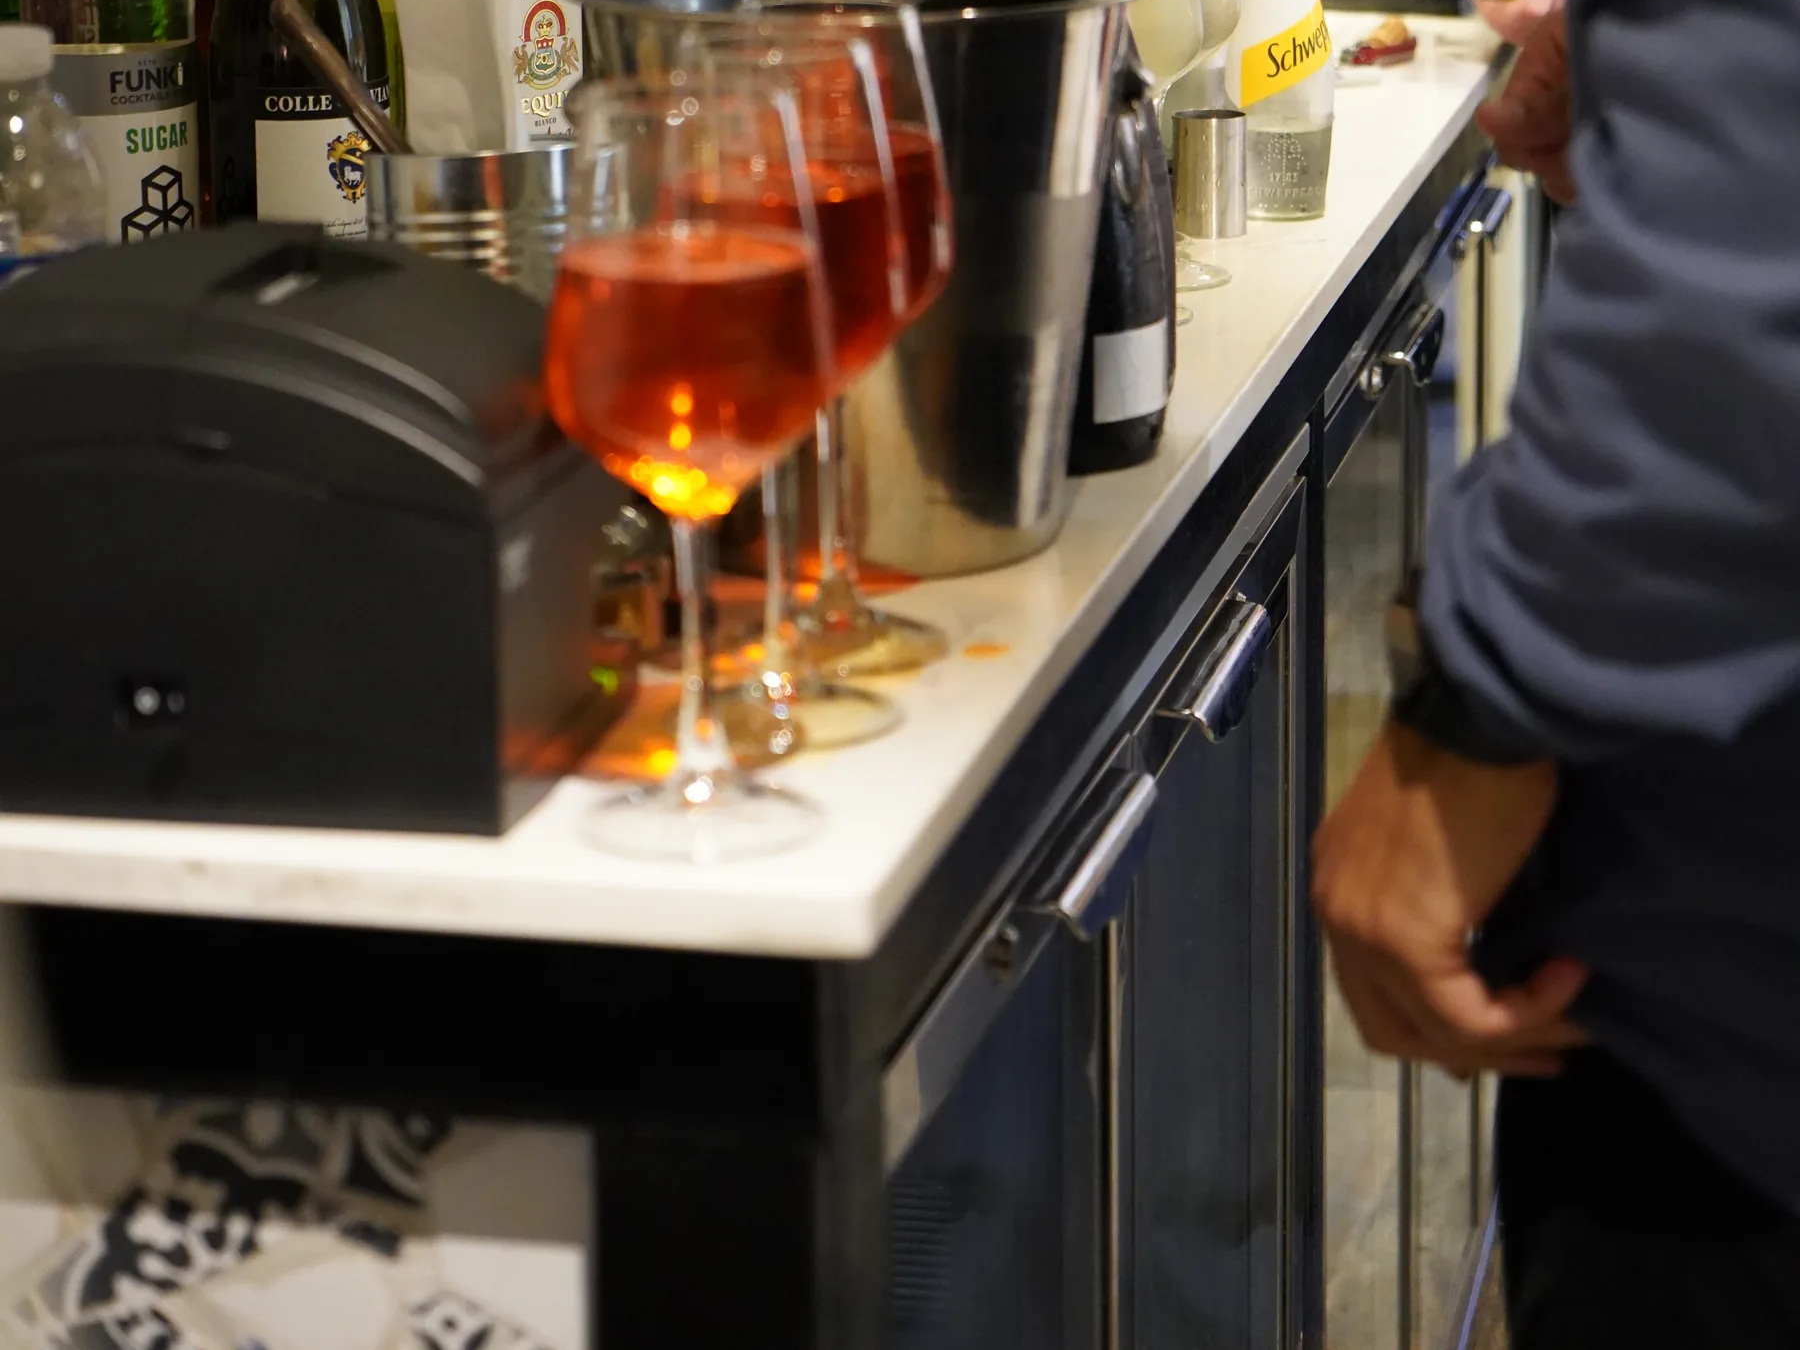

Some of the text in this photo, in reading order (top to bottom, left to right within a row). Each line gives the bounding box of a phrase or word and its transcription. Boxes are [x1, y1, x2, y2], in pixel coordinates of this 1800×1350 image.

[265, 94, 333, 112] COLLE
[535, 117, 557, 127] BLANCO
[126, 121, 188, 154] SUGAR
